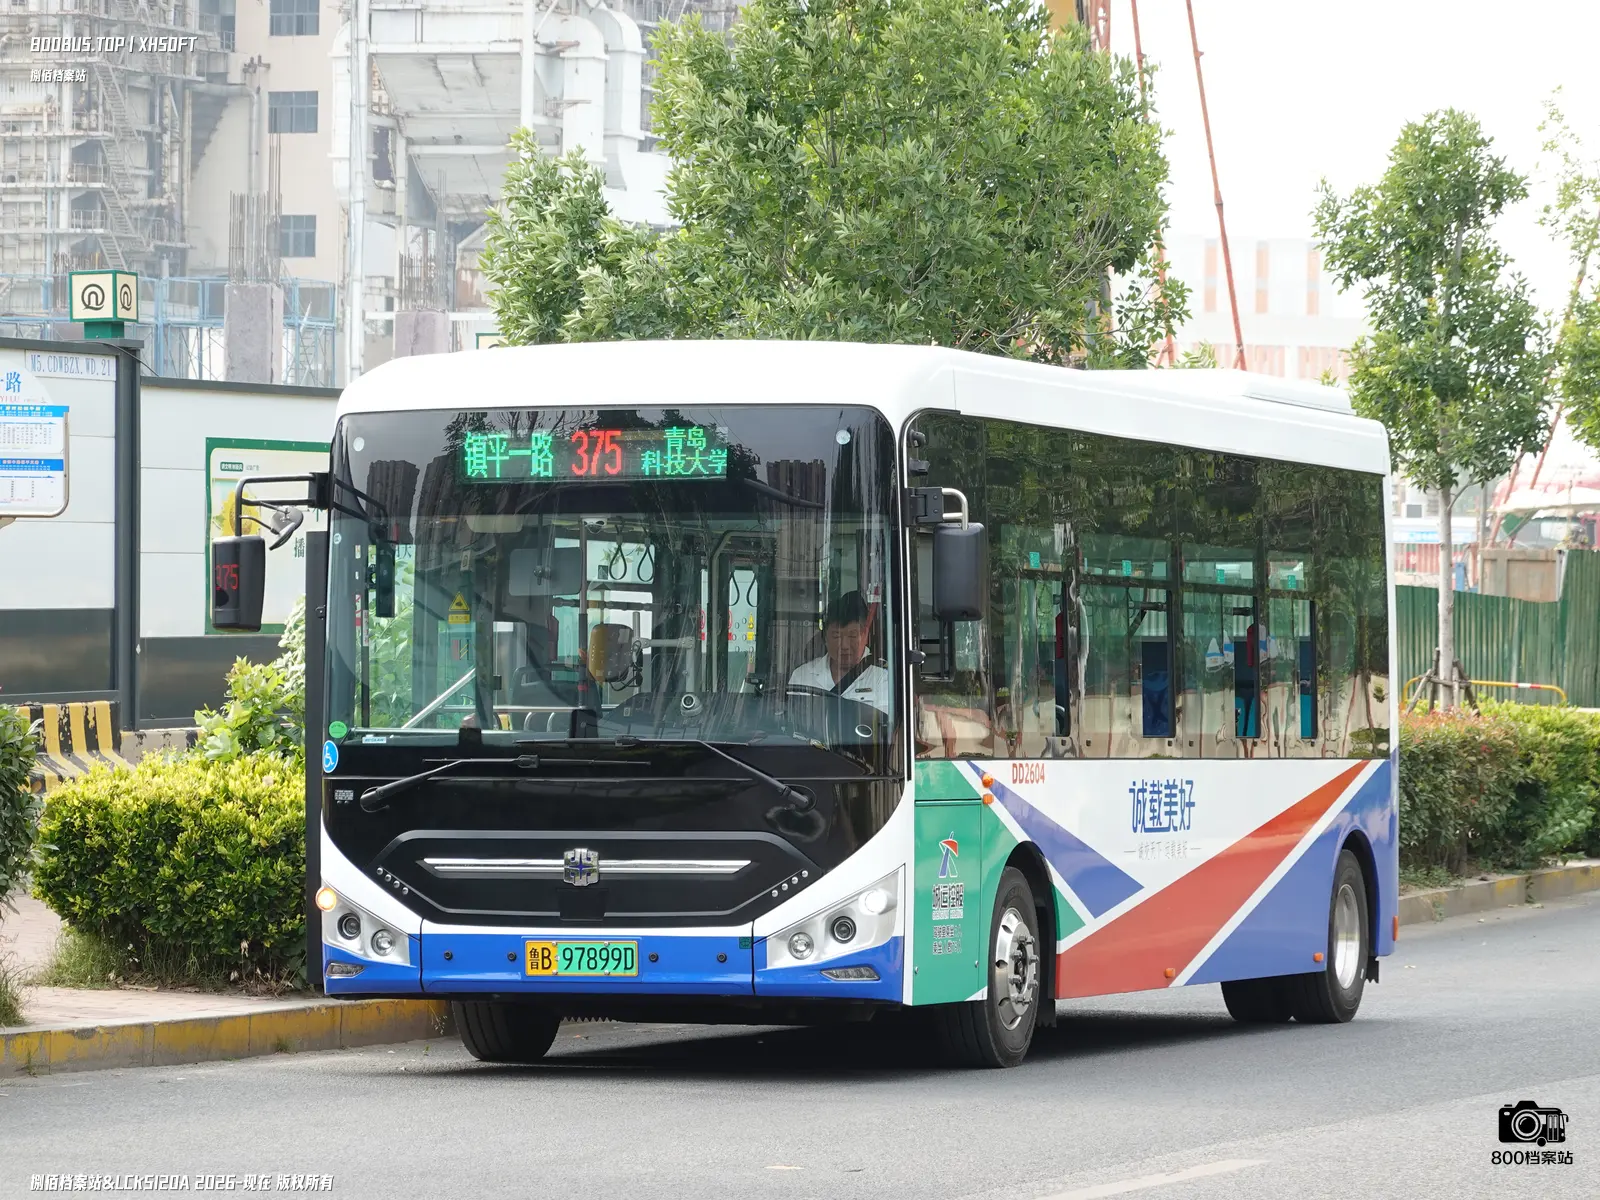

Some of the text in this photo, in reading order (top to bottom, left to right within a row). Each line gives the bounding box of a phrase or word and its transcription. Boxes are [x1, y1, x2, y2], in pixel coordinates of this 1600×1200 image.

[0, 371, 22, 393] 路
[663, 426, 706, 450] 青岛
[464, 431, 554, 478] 镇平一路
[571, 429, 622, 476] 375
[641, 448, 728, 476] 科技大学
[1012, 762, 1045, 784] DD2604
[1128, 778, 1196, 833] 诚载美好
[529, 947, 635, 971] 鲁B 97899D
